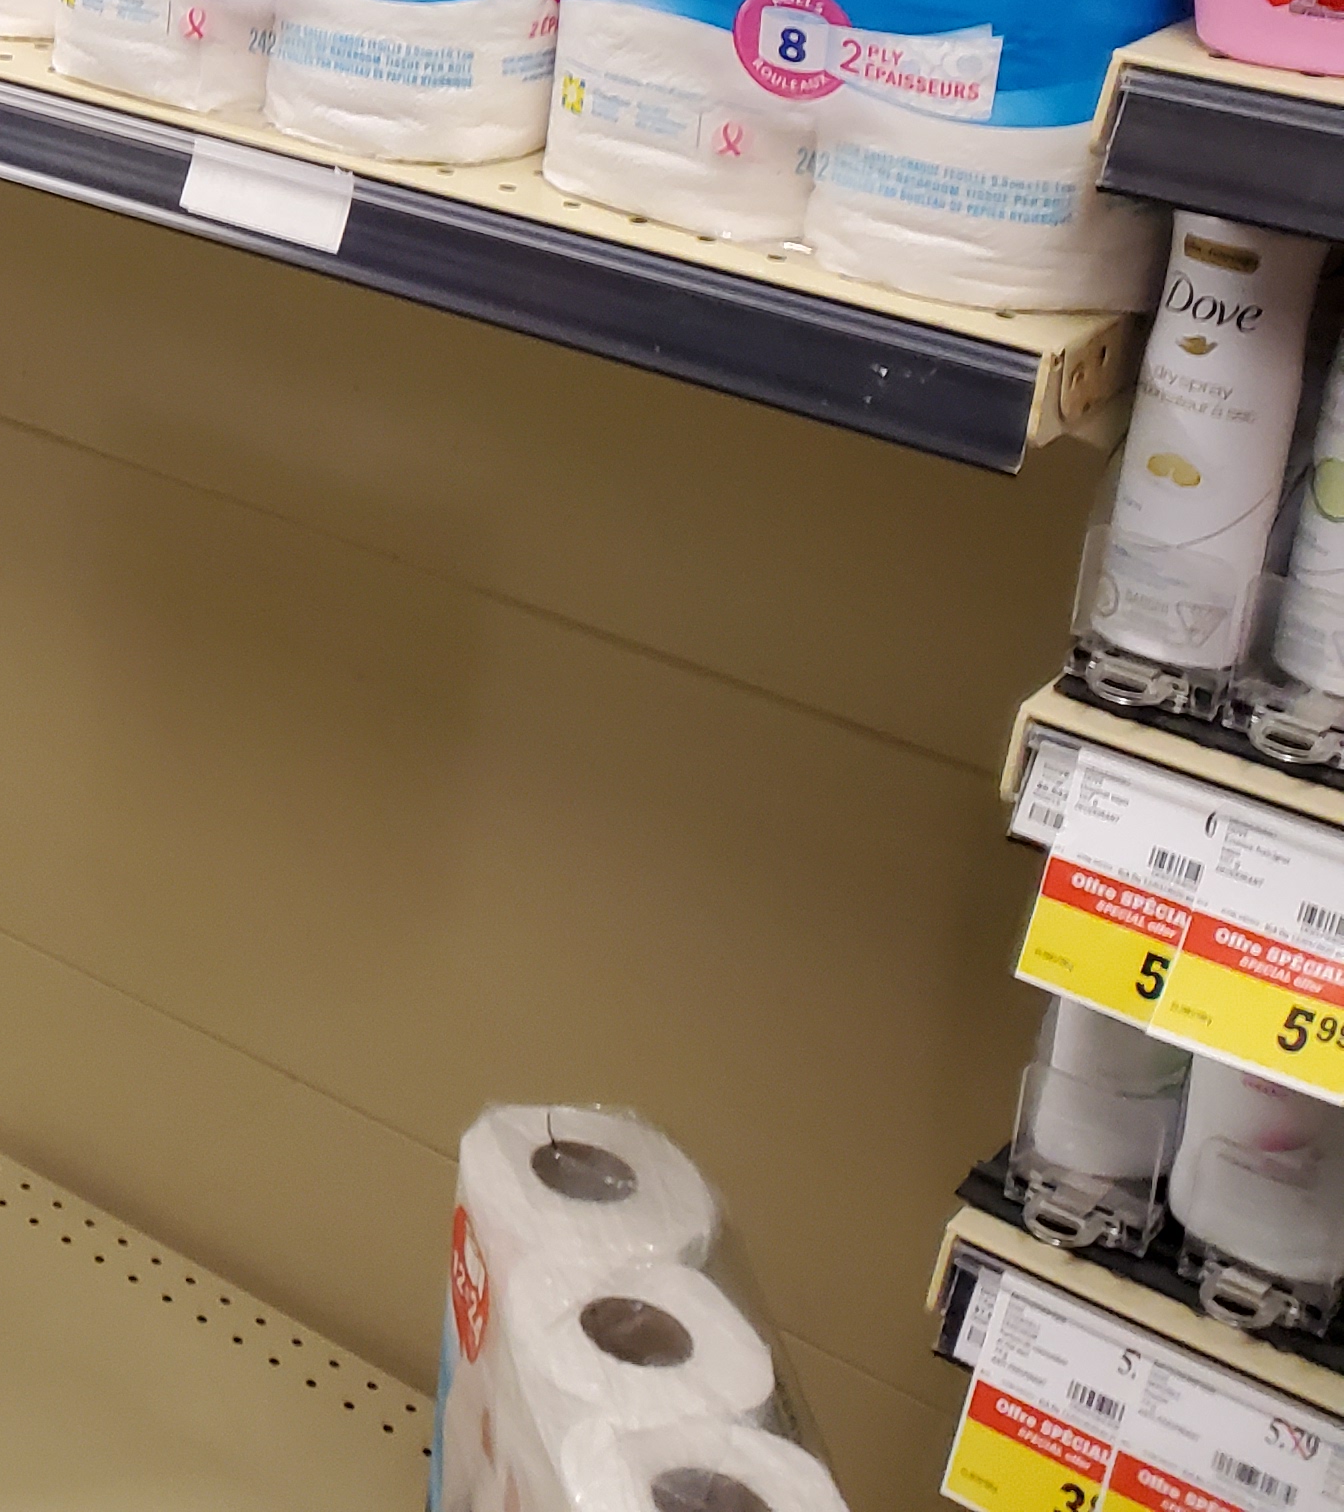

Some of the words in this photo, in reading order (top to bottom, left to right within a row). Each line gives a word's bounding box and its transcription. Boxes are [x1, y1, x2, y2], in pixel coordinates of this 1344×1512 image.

[778, 28, 807, 64] 8
[839, 39, 862, 75] 2
[866, 44, 906, 66] PLY
[752, 56, 833, 94] ROULEAUX
[864, 61, 982, 102] ÉPAISSEURS
[1164, 270, 1265, 334] Dove
[1070, 871, 1117, 901] Offre
[1213, 926, 1263, 957] Offre
[1134, 951, 1171, 1001] 5
[994, 1395, 1038, 1430] Offre
